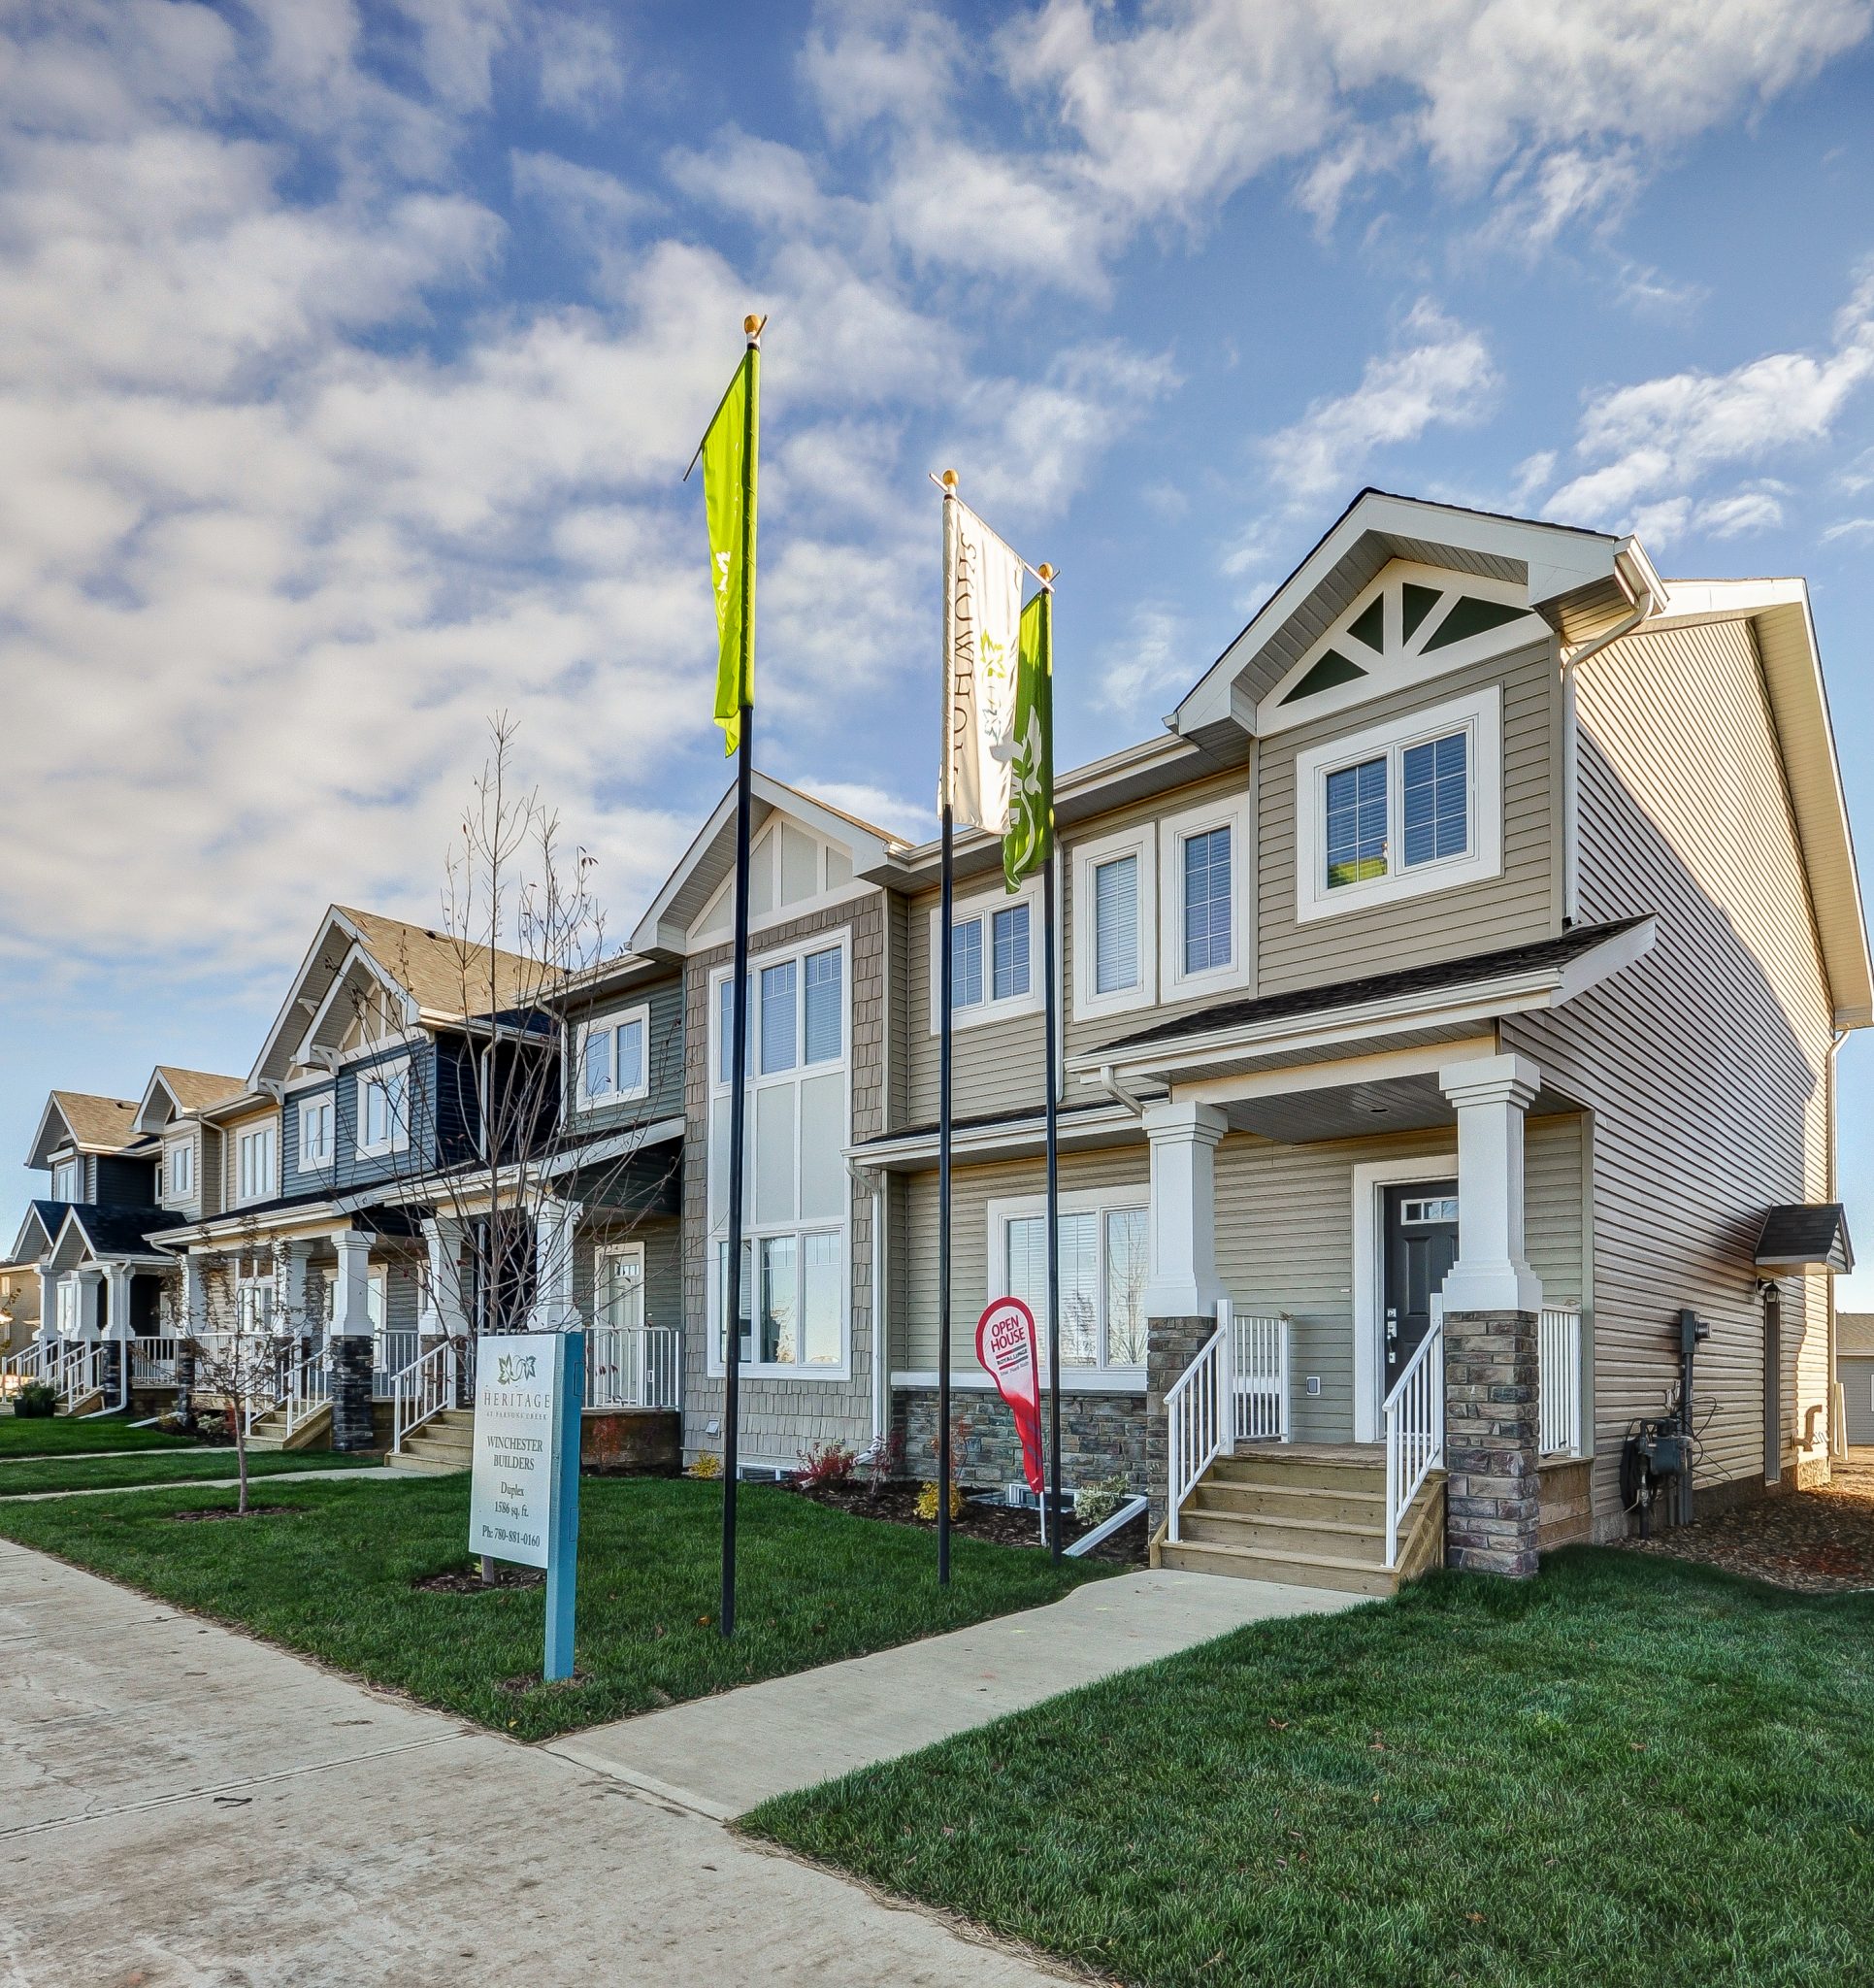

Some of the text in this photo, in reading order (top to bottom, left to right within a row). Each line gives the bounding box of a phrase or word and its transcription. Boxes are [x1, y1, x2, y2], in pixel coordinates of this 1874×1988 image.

[991, 1314, 1019, 1338] OPEN
[990, 1327, 1026, 1352] HOUSE
[484, 1392, 550, 1408] HERITAGE
[486, 1436, 543, 1452] WINCHESTER
[493, 1454, 535, 1471] BUILDERS
[501, 1481, 524, 1499] Duplex
[495, 1501, 510, 1514] 1586
